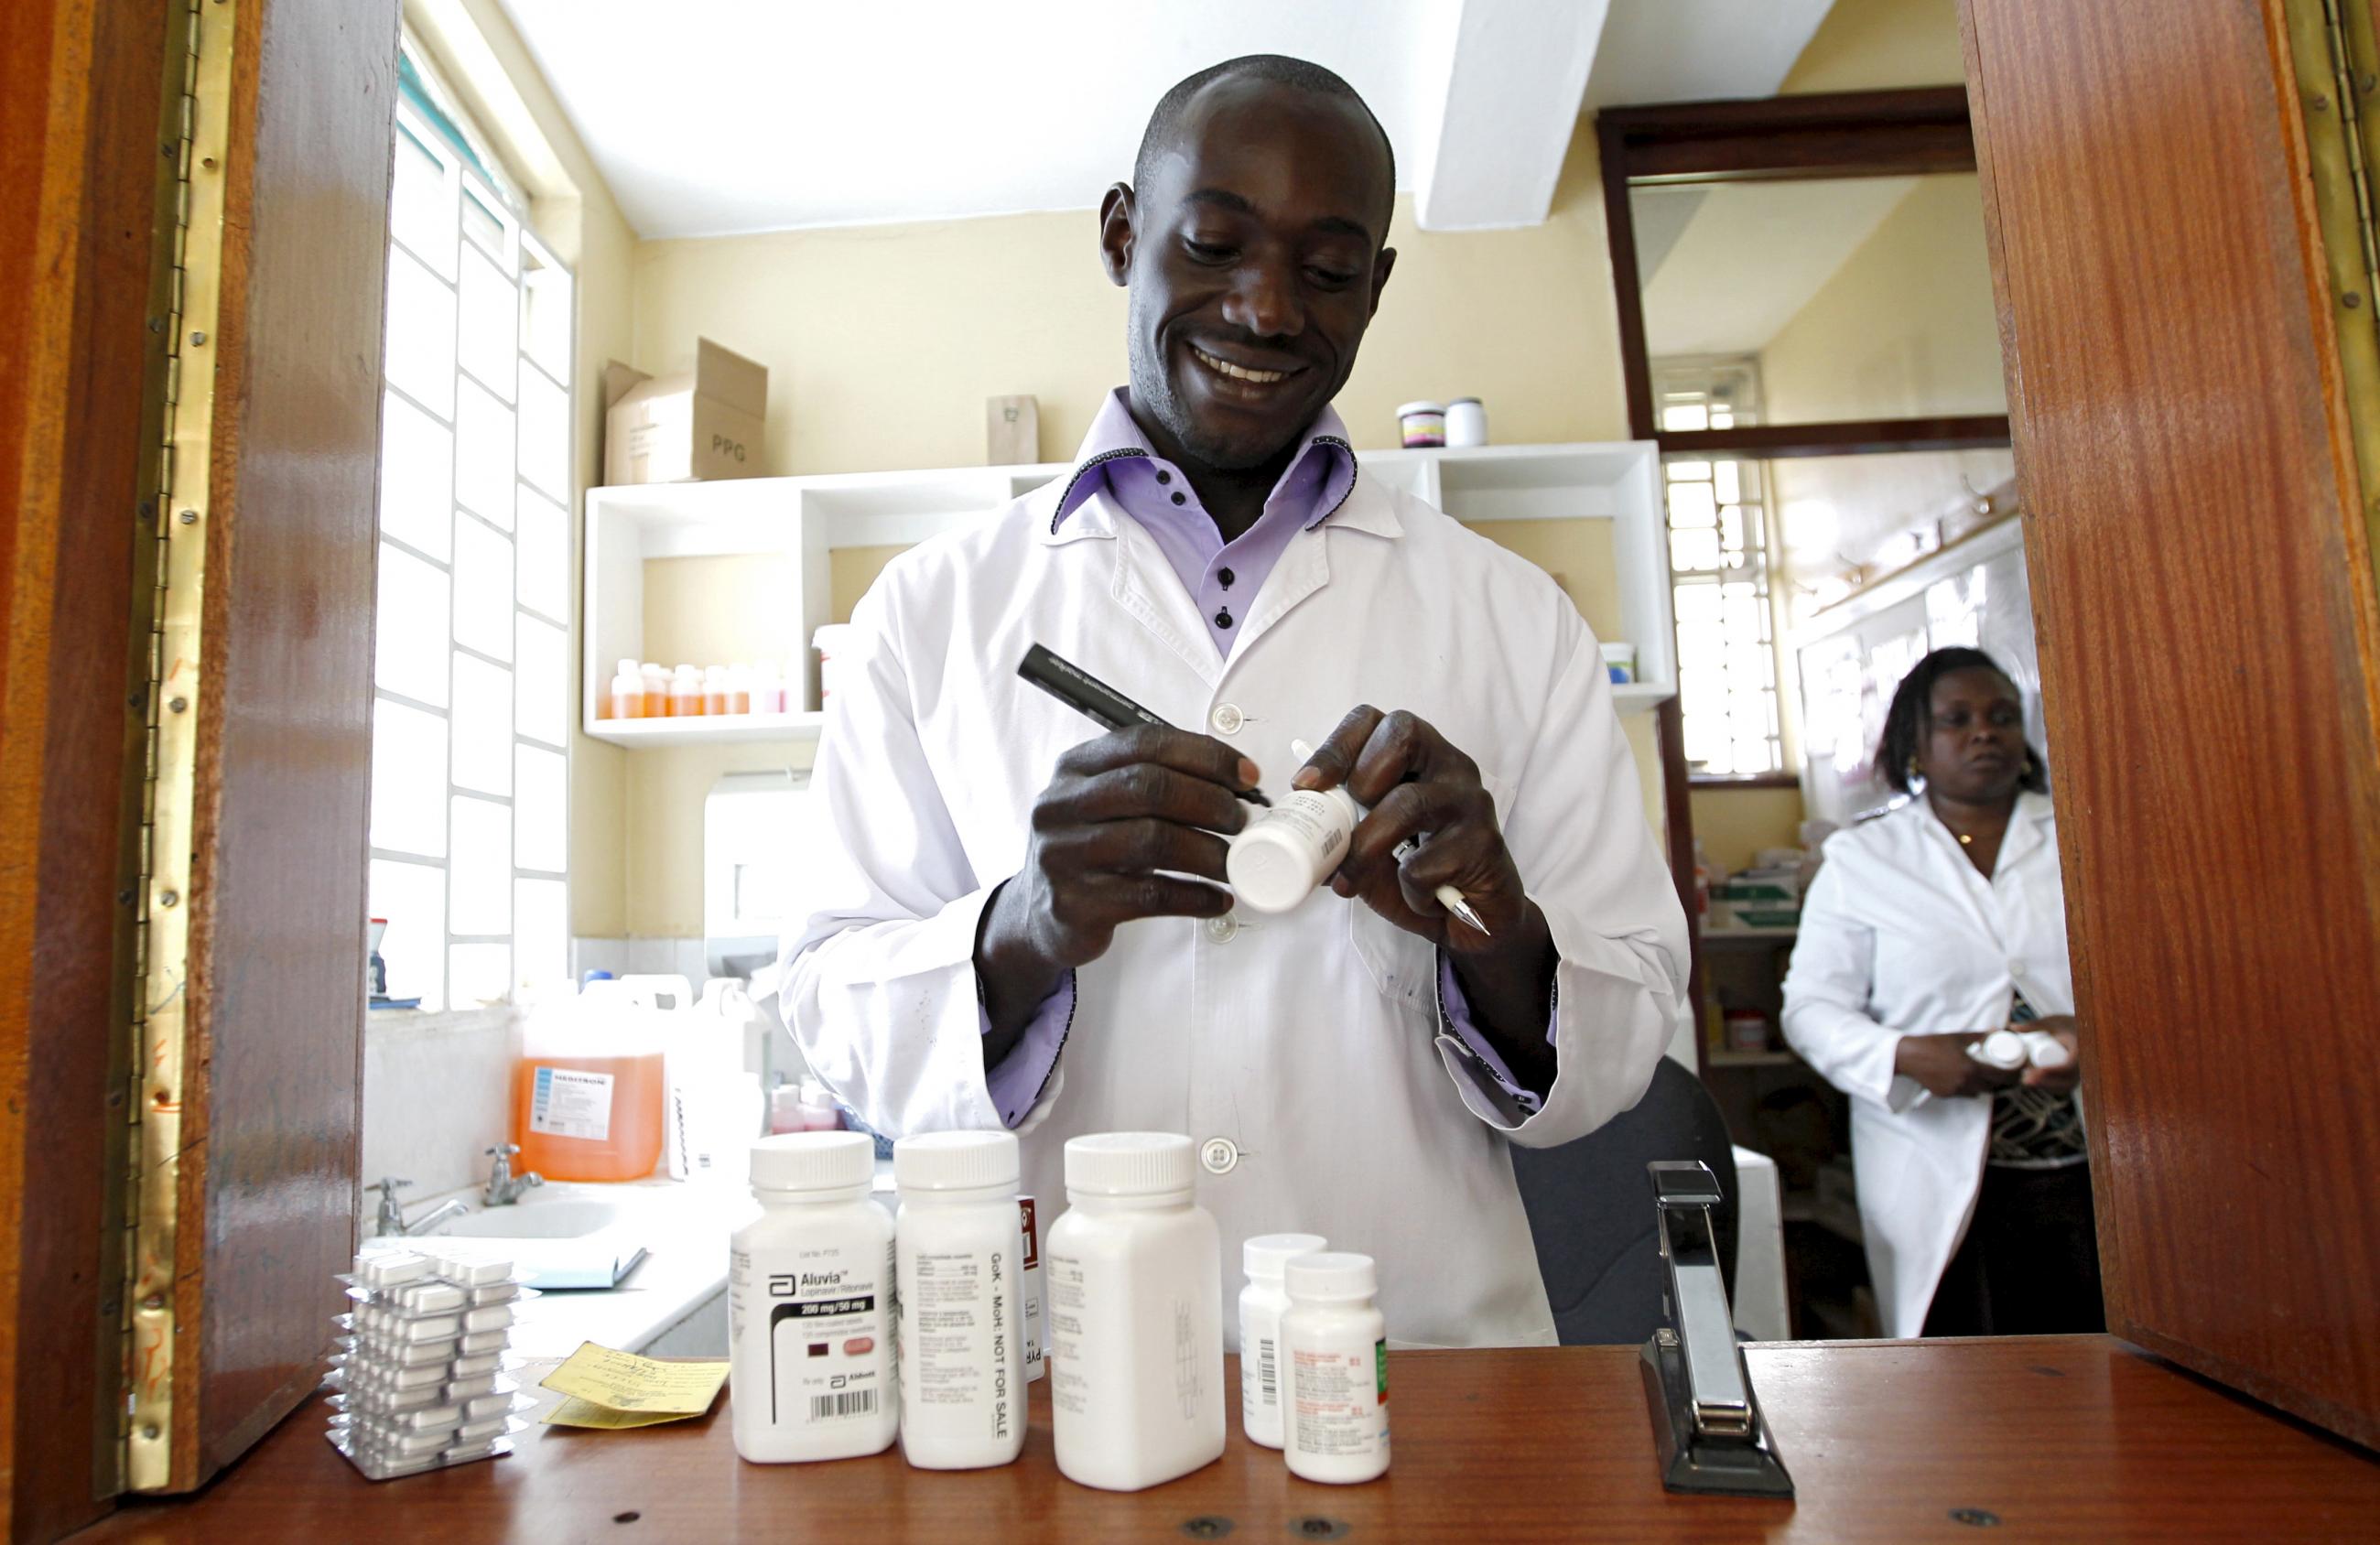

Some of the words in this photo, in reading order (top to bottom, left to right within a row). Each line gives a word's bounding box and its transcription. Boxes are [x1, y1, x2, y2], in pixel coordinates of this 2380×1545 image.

[711, 434, 746, 462] PPG
[991, 1253, 1001, 1282] GoK
[801, 1303, 818, 1315] 200
[851, 1300, 866, 1311] mg
[994, 1334, 1005, 1365] NOT
[995, 1368, 1006, 1399] FOR
[996, 1402, 1008, 1439] SALE
